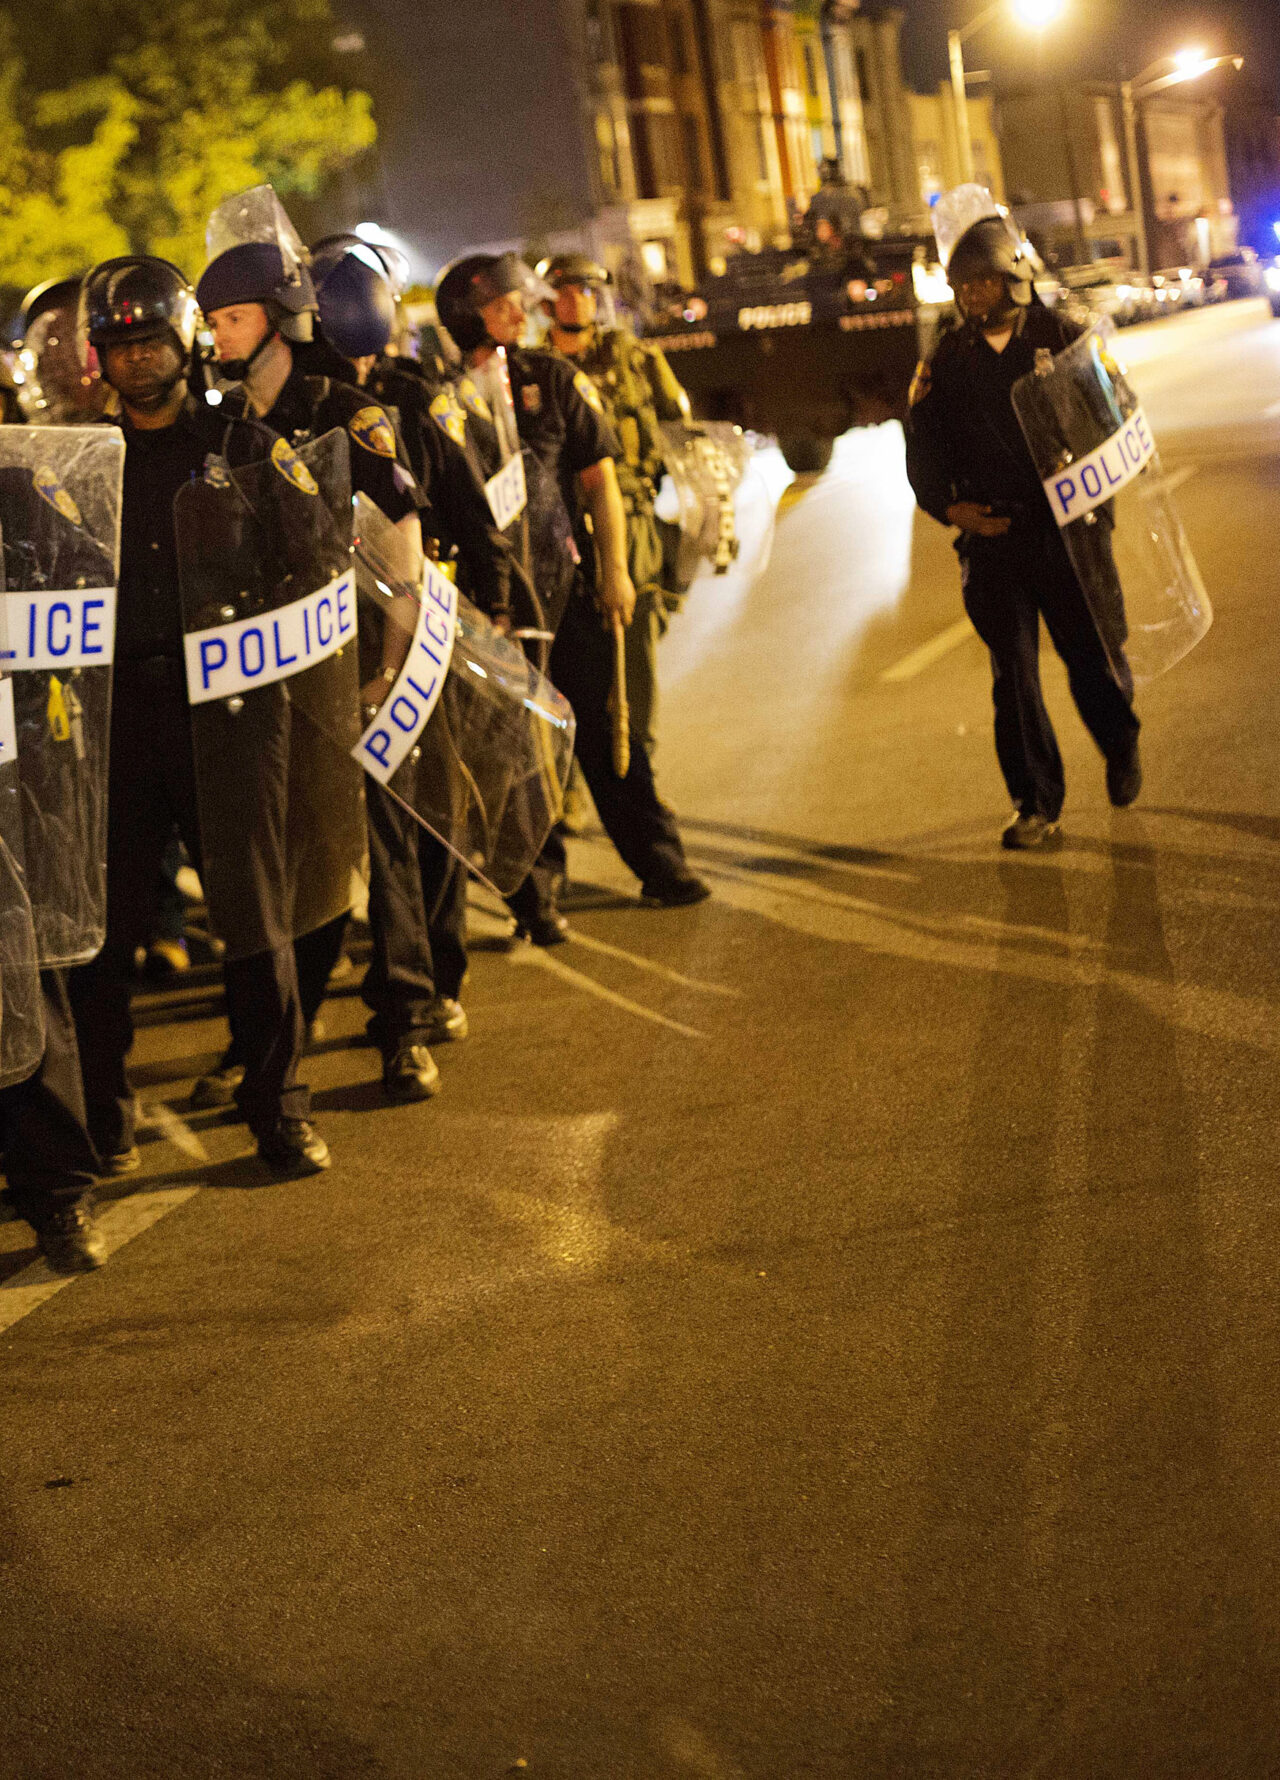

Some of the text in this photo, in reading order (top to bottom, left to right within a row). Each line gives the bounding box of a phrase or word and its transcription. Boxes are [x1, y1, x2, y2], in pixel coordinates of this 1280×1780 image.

[1055, 416, 1150, 514] POLICE
[200, 583, 350, 689] POLICE
[365, 573, 451, 768] POLICE
